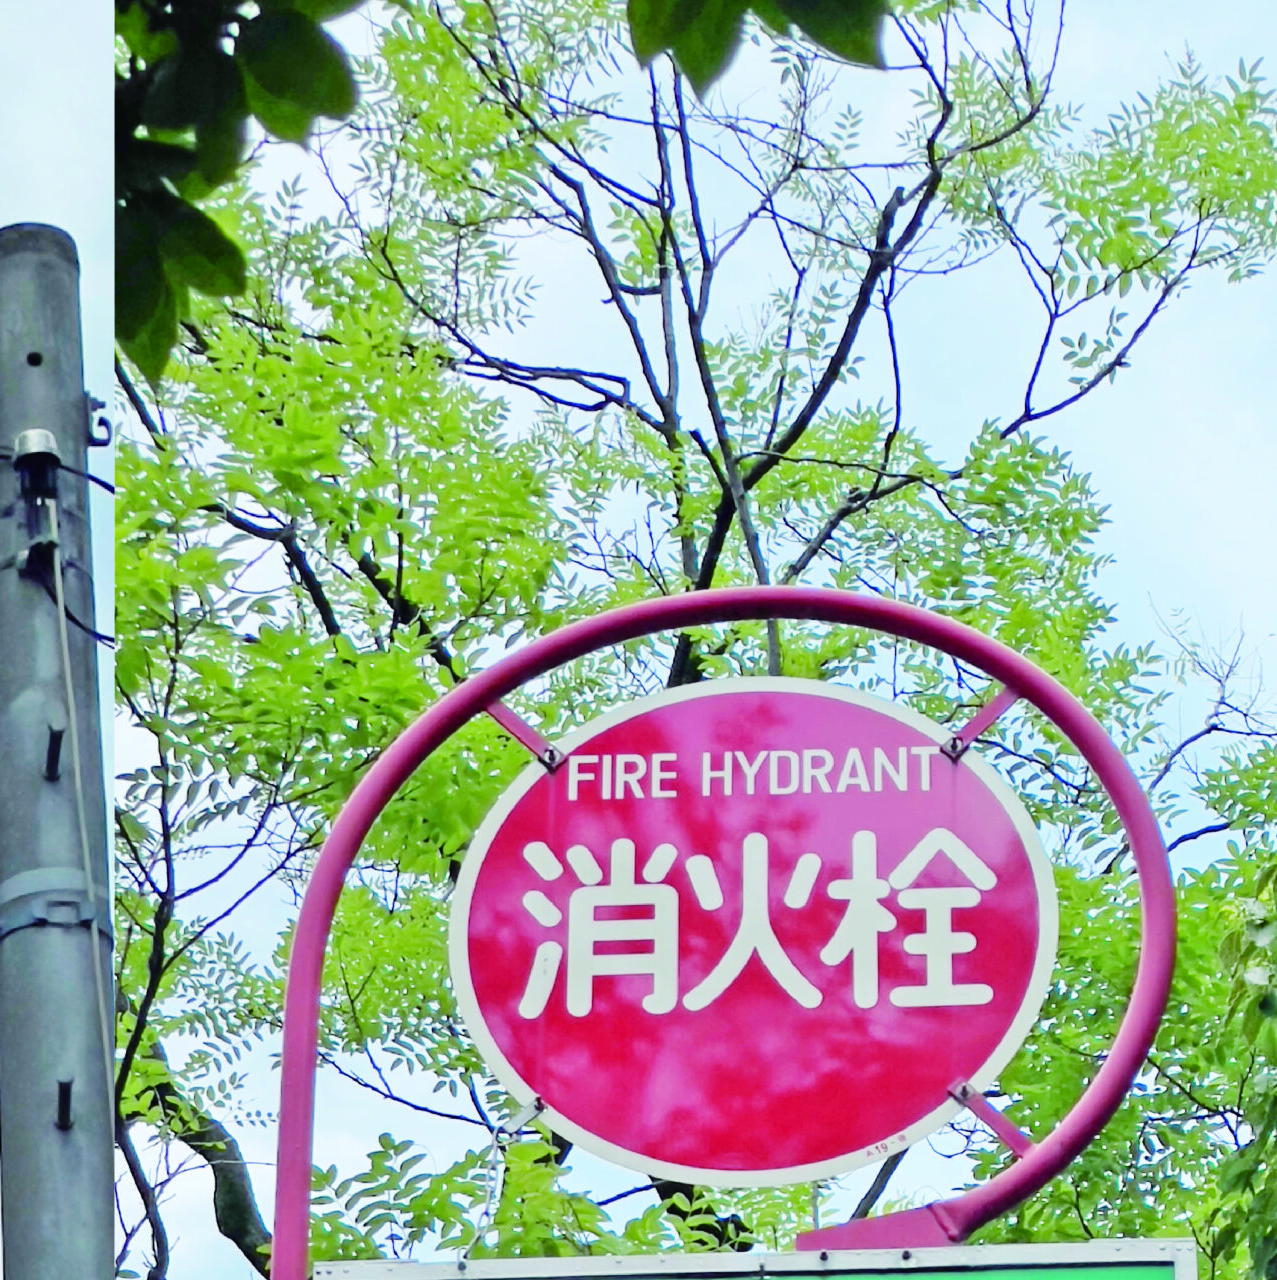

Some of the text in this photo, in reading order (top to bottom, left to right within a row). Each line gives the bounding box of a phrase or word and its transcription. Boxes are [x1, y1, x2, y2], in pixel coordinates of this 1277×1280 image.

[567, 746, 942, 801] FIRE HYDRANT
[517, 827, 999, 1020] 消火栓
